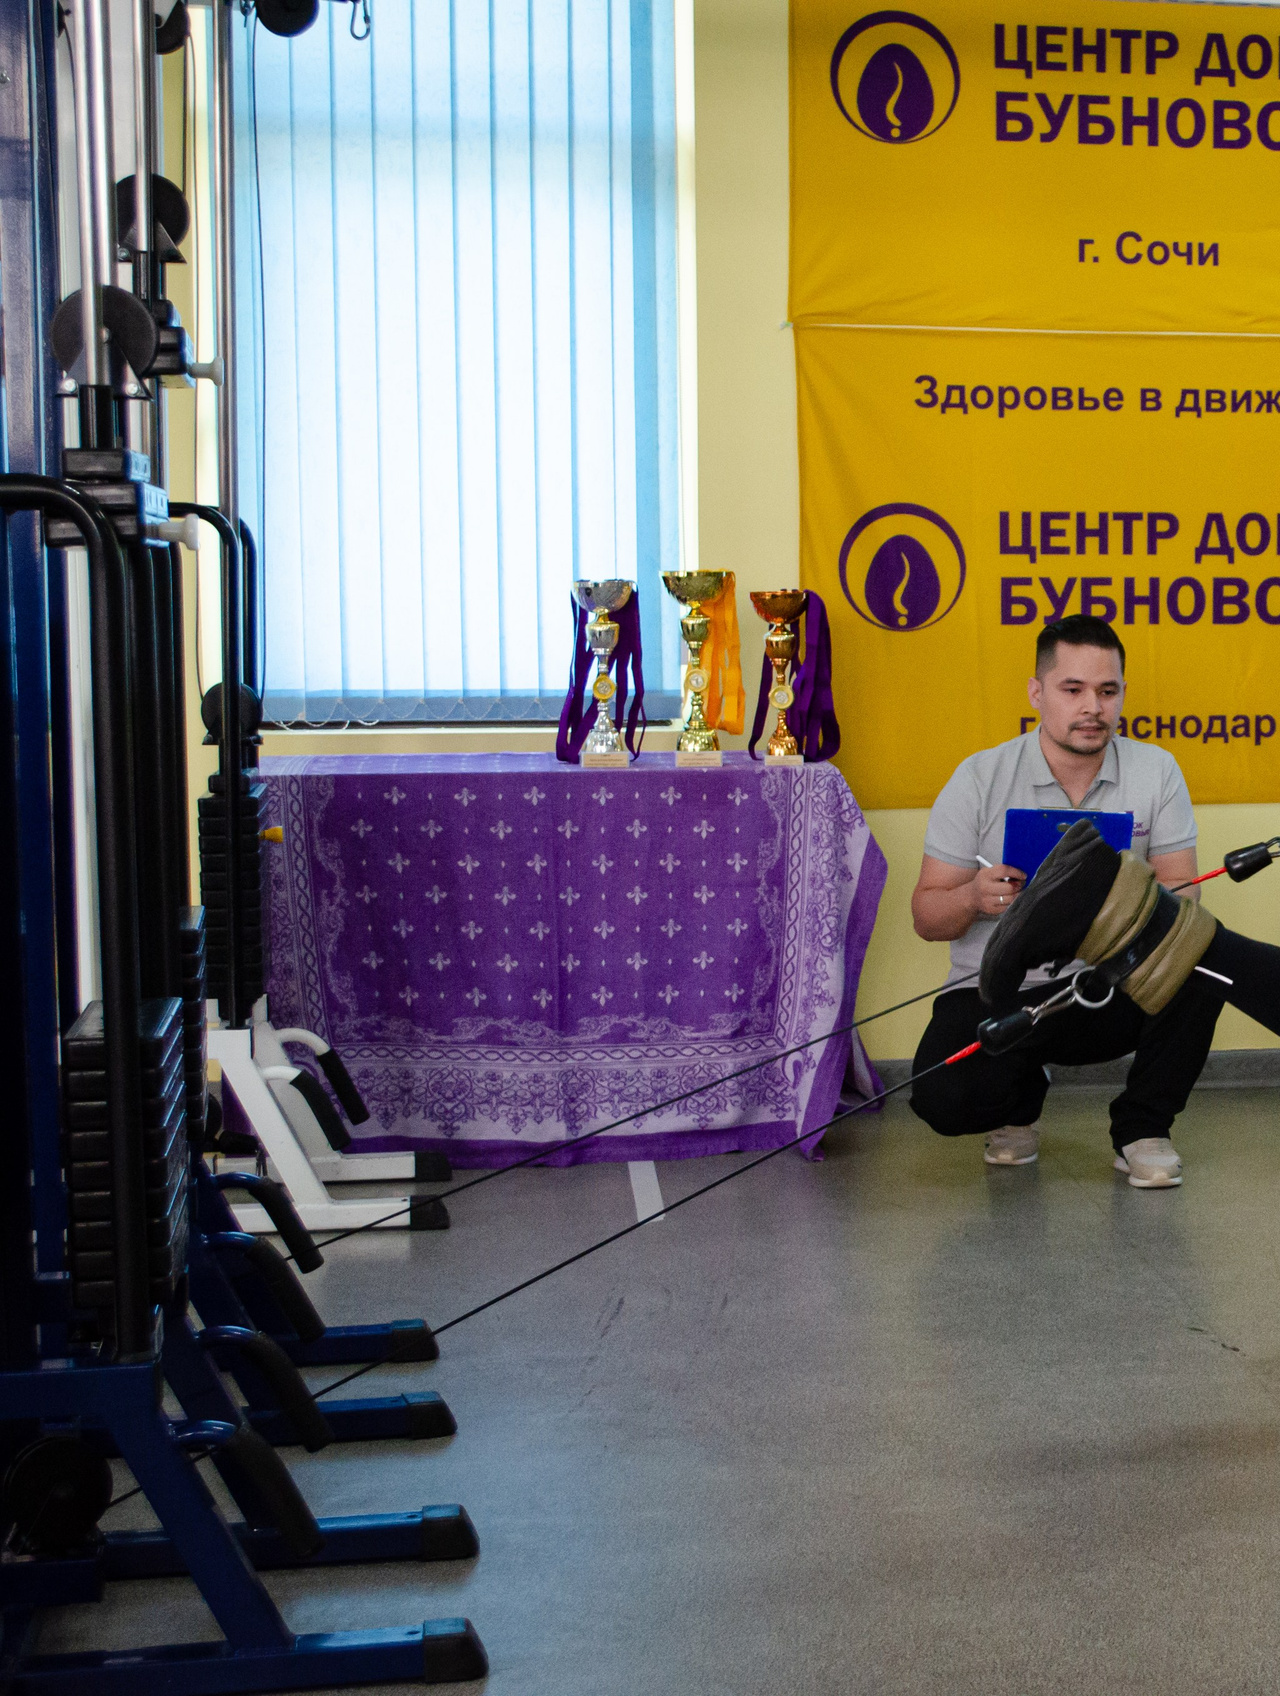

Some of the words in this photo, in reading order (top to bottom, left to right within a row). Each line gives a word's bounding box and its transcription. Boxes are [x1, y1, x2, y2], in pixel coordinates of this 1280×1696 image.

[993, 22, 1180, 80] ЦЕНТР
[1077, 237, 1100, 264] г.
[1114, 230, 1220, 267] Сочи
[913, 373, 1125, 419] Здоровье
[1140, 387, 1163, 412] в
[999, 511, 1180, 564] ЦЕНТР
